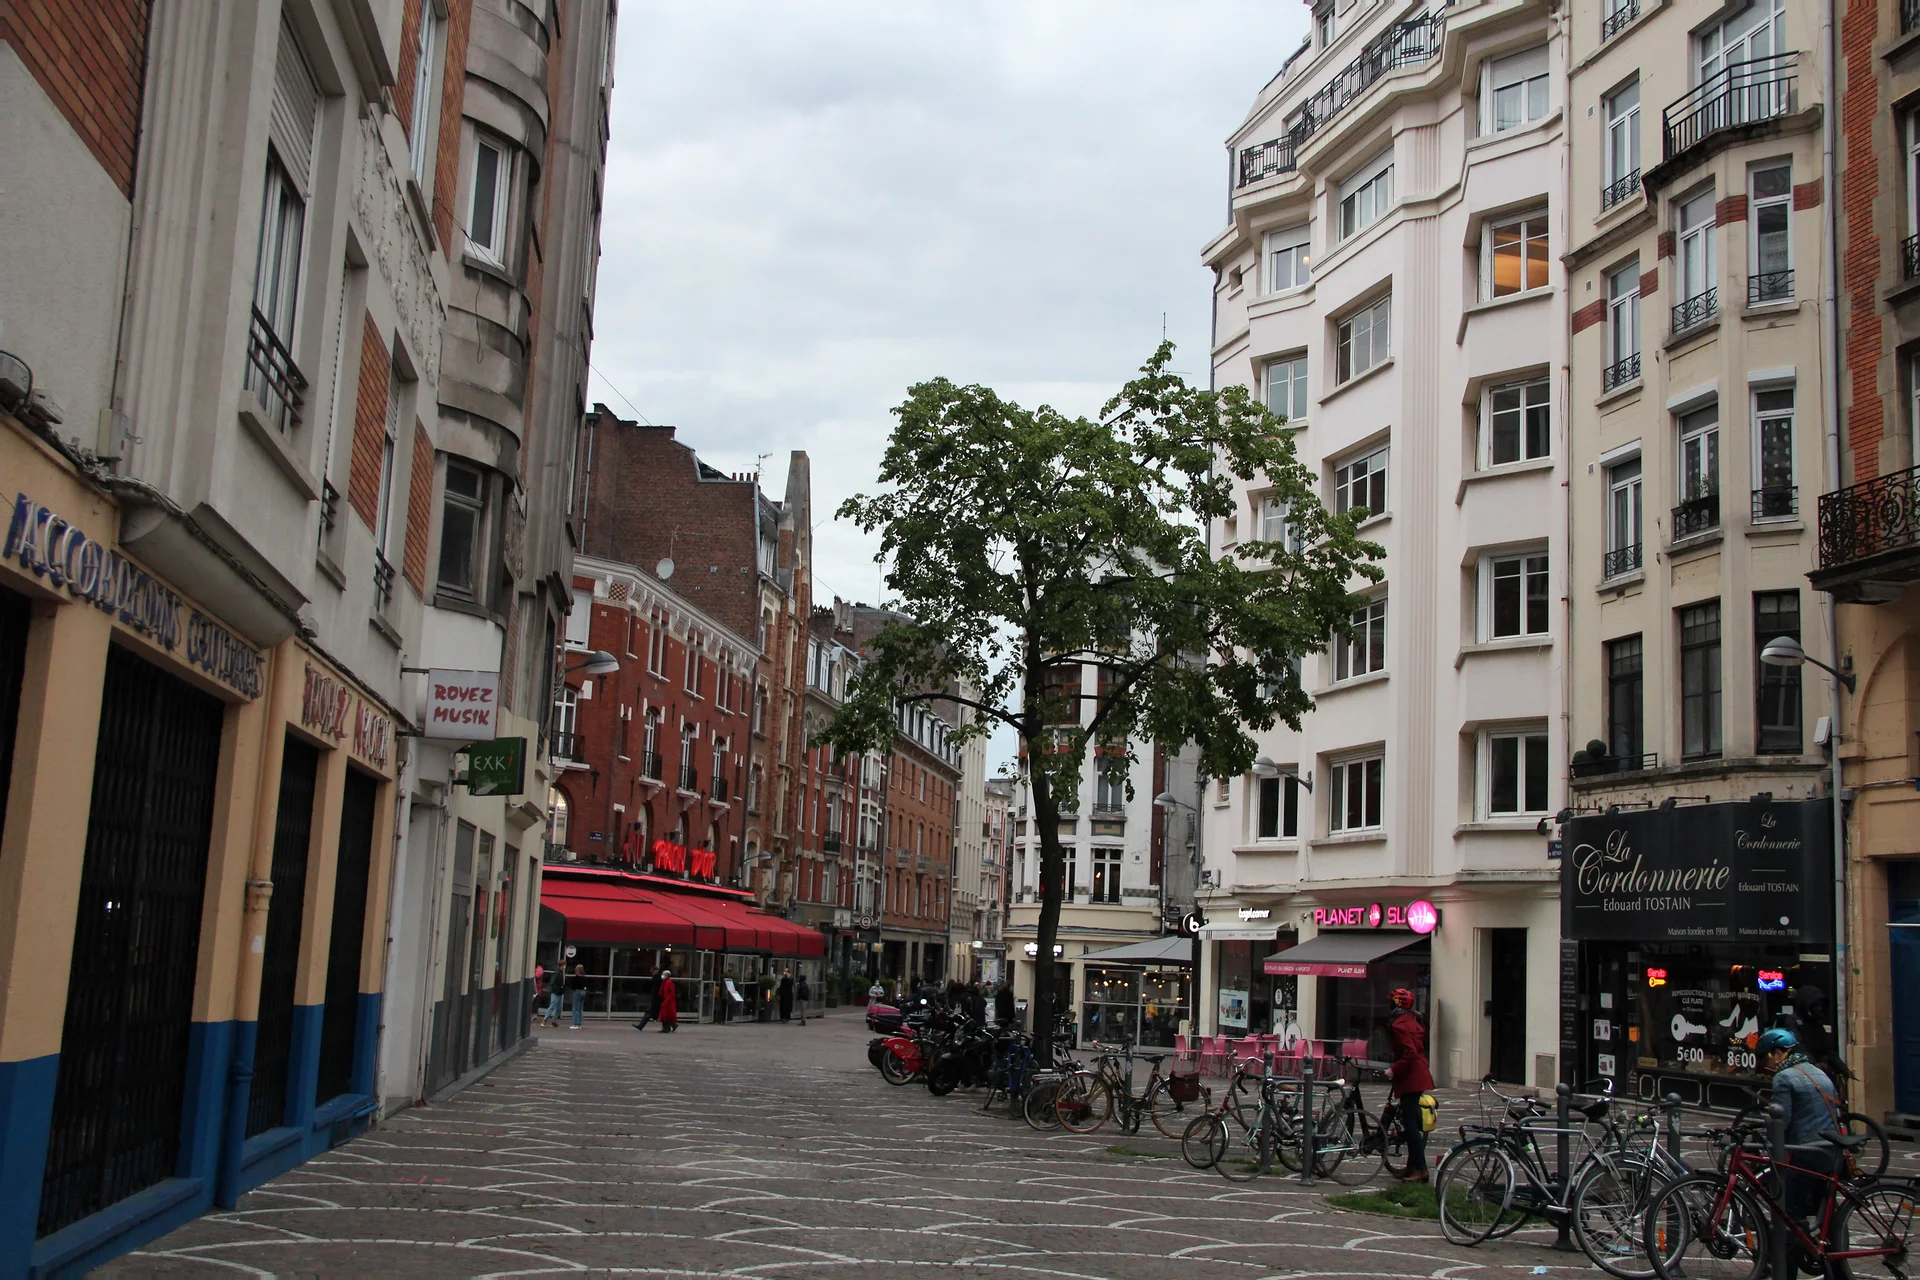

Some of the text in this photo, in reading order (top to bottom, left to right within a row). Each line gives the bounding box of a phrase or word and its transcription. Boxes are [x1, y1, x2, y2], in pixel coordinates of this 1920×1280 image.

[434, 684, 493, 703] ROYEZ
[433, 706, 490, 726] MUSIK
[1761, 811, 1776, 828] La
[1603, 829, 1631, 863] La
[1735, 829, 1801, 850] Cordonnerie
[1572, 843, 1731, 895] Cordonnerie
[1738, 882, 1799, 892] Edouard TOSTAIN
[1603, 897, 1691, 911] Edouard TOSTAIN
[1315, 905, 1407, 926] PLANET SU
[1667, 927, 1687, 936] Maison
[1714, 926, 1729, 936] 1918
[1738, 927, 1758, 936] Maison
[1786, 928, 1800, 936] 1918
[1758, 969, 1782, 980] Service
[1671, 989, 1715, 999] REPRODUCTION DE
[1676, 1046, 1704, 1063] 5€00
[1727, 1050, 1757, 1068] 8€00
